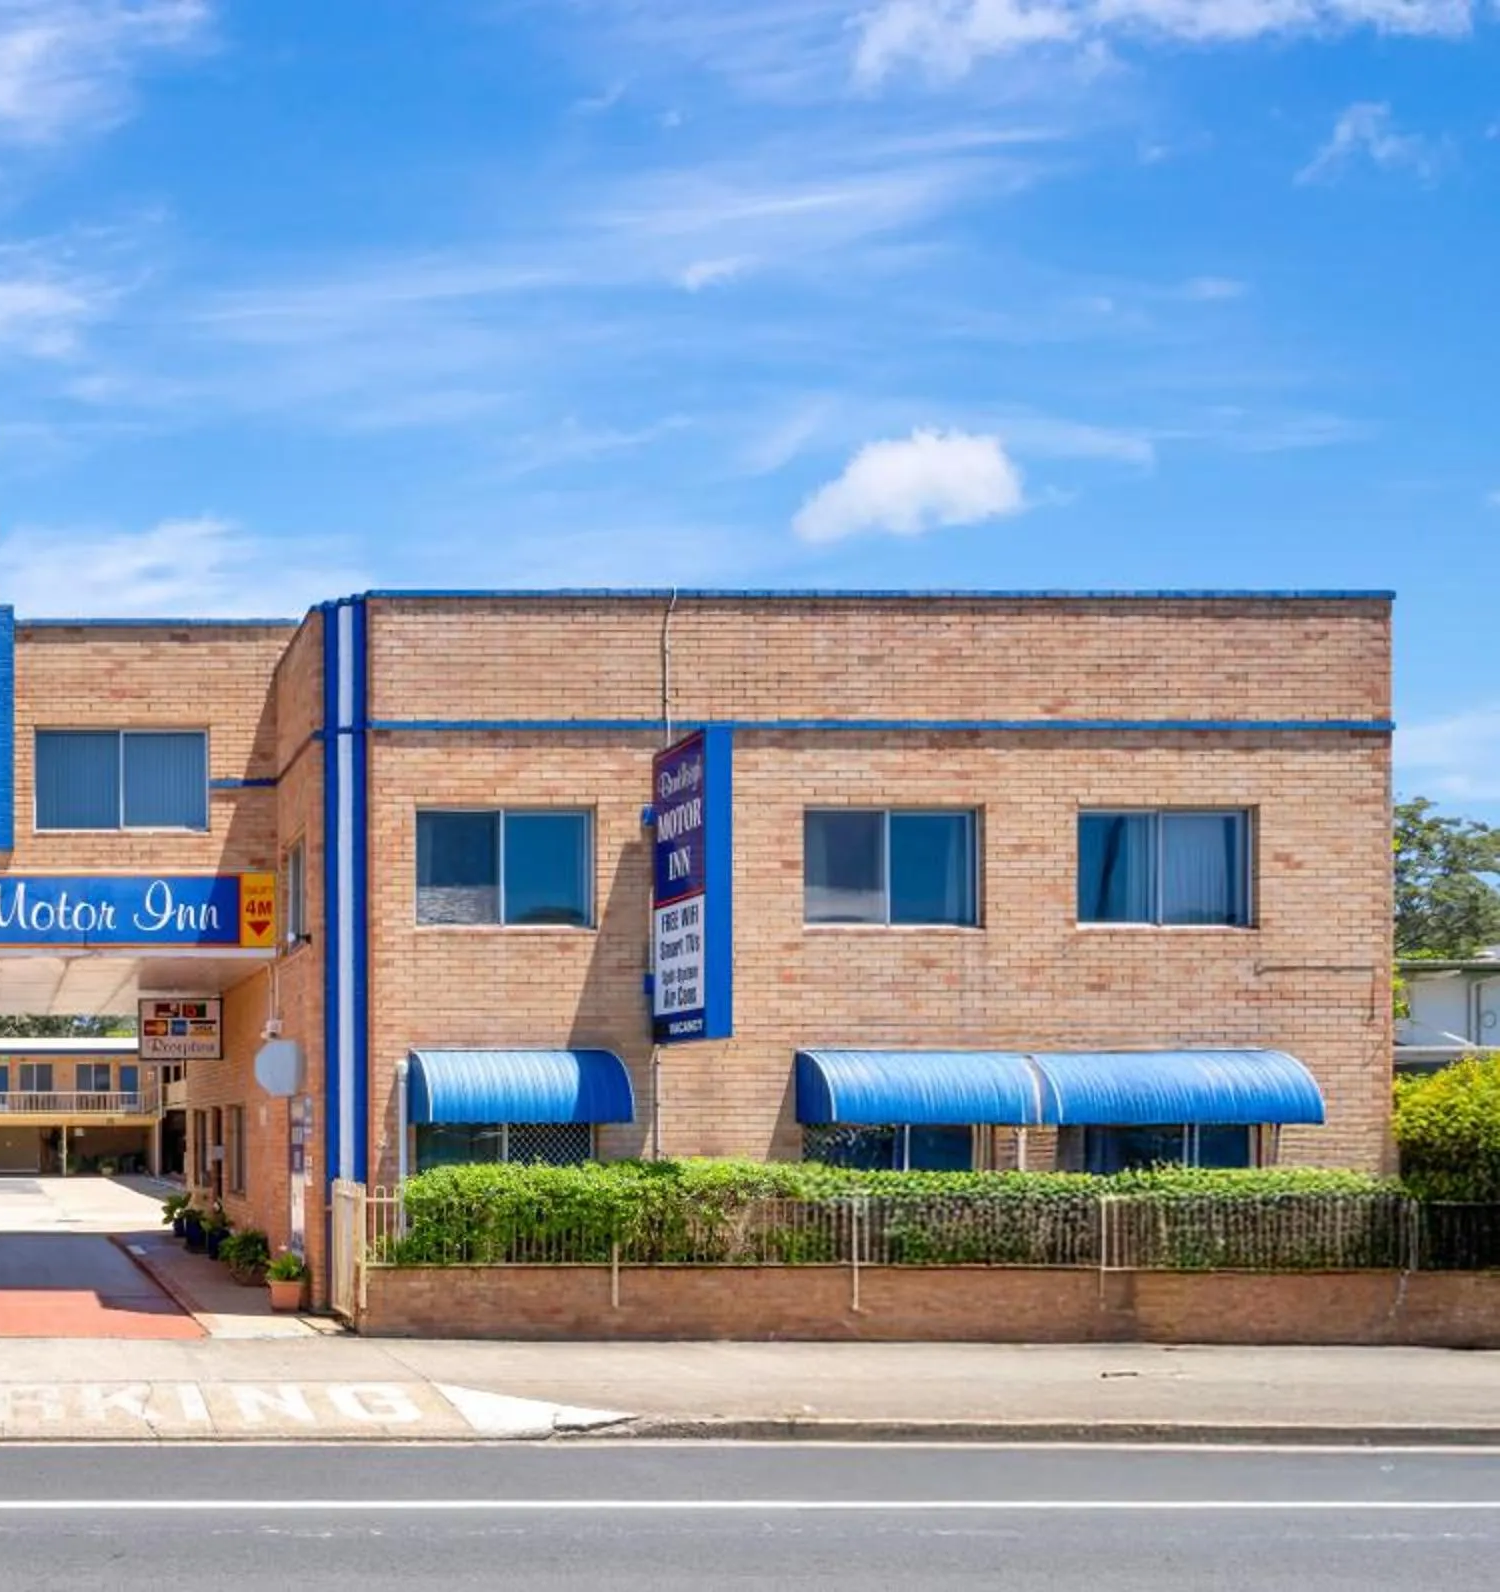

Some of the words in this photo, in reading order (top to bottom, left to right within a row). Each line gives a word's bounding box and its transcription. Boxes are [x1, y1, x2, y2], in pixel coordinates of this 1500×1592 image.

[658, 797, 702, 843] MOTOR
[668, 845, 691, 881] INN
[133, 880, 220, 932] Inn
[245, 899, 272, 917] 4M
[661, 910, 679, 933] FREE
[660, 938, 683, 960] Smart
[663, 989, 676, 1009] Air
[669, 1019, 703, 1035] VACANCY
[145, 1038, 216, 1056] Reception
